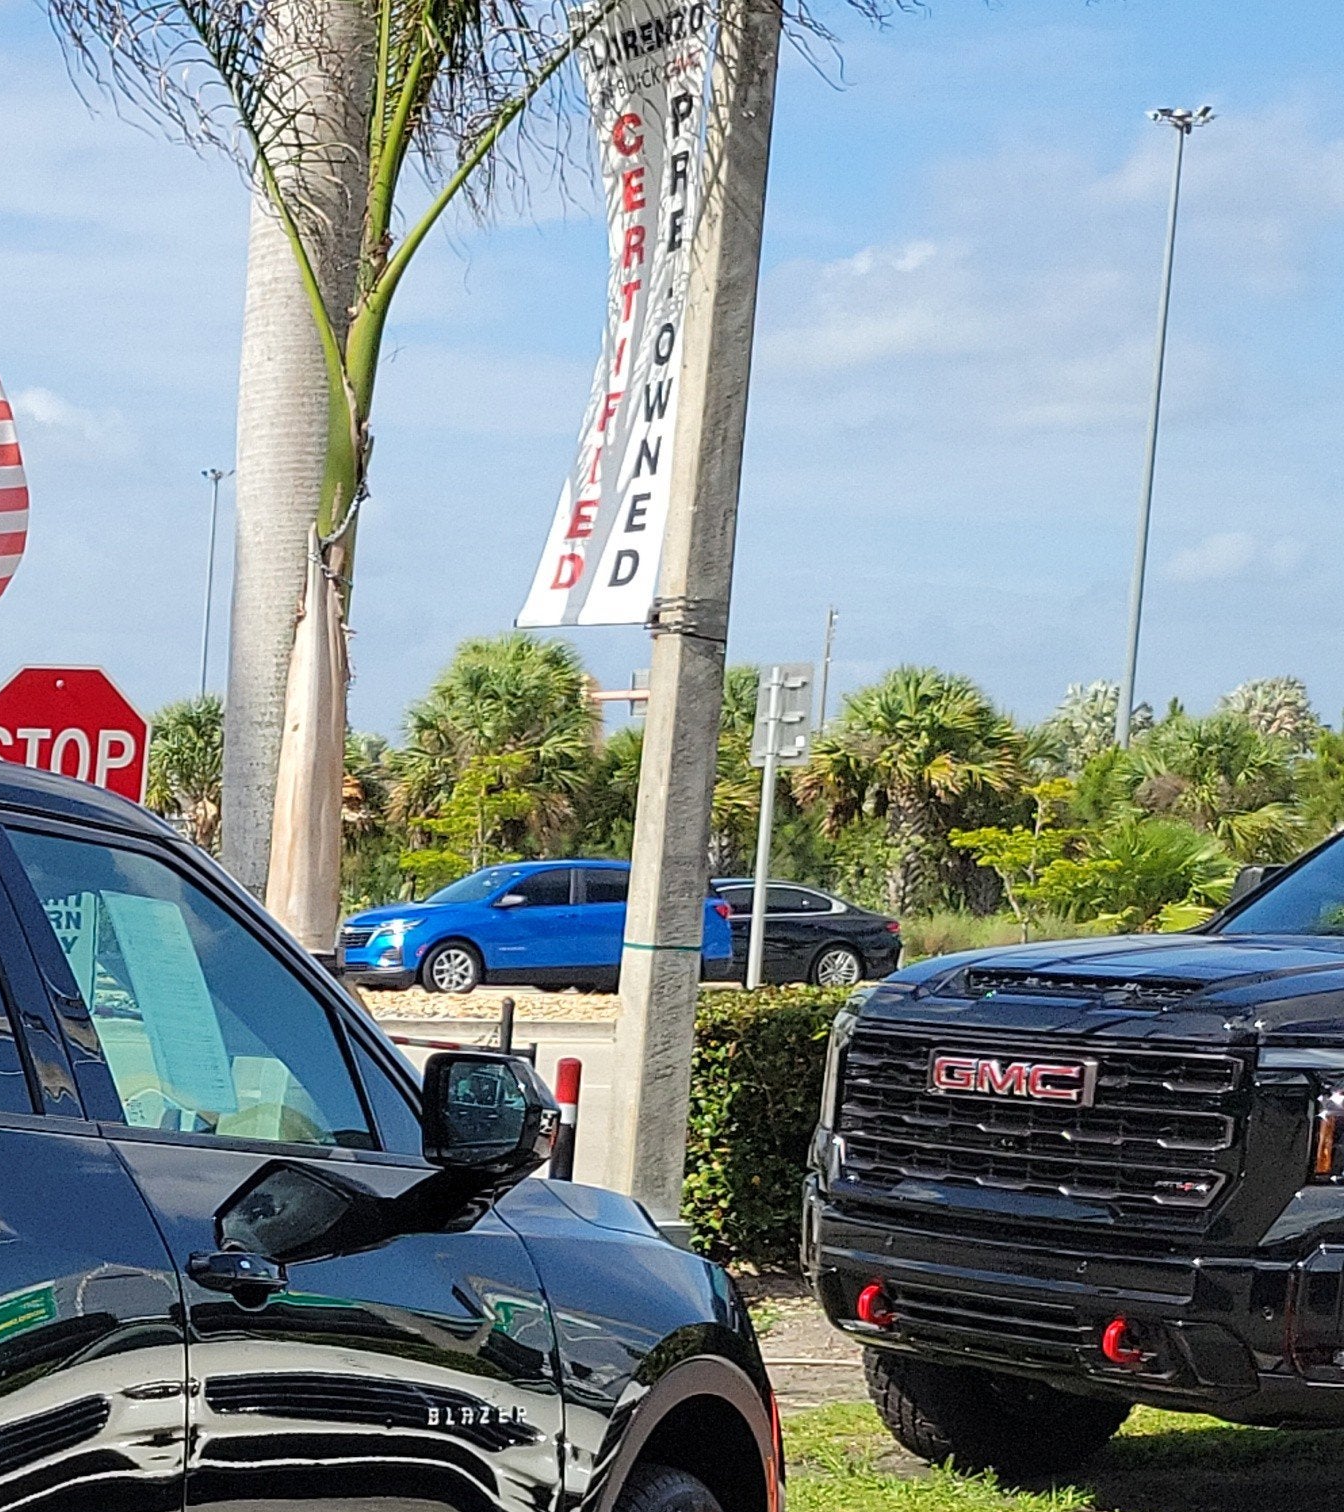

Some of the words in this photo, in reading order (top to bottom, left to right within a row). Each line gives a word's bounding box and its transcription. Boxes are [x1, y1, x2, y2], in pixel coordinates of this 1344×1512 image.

[550, 112, 646, 590] CERTIFIED
[934, 1056, 1081, 1100] GMC
[427, 1404, 527, 1426] BLAZER
